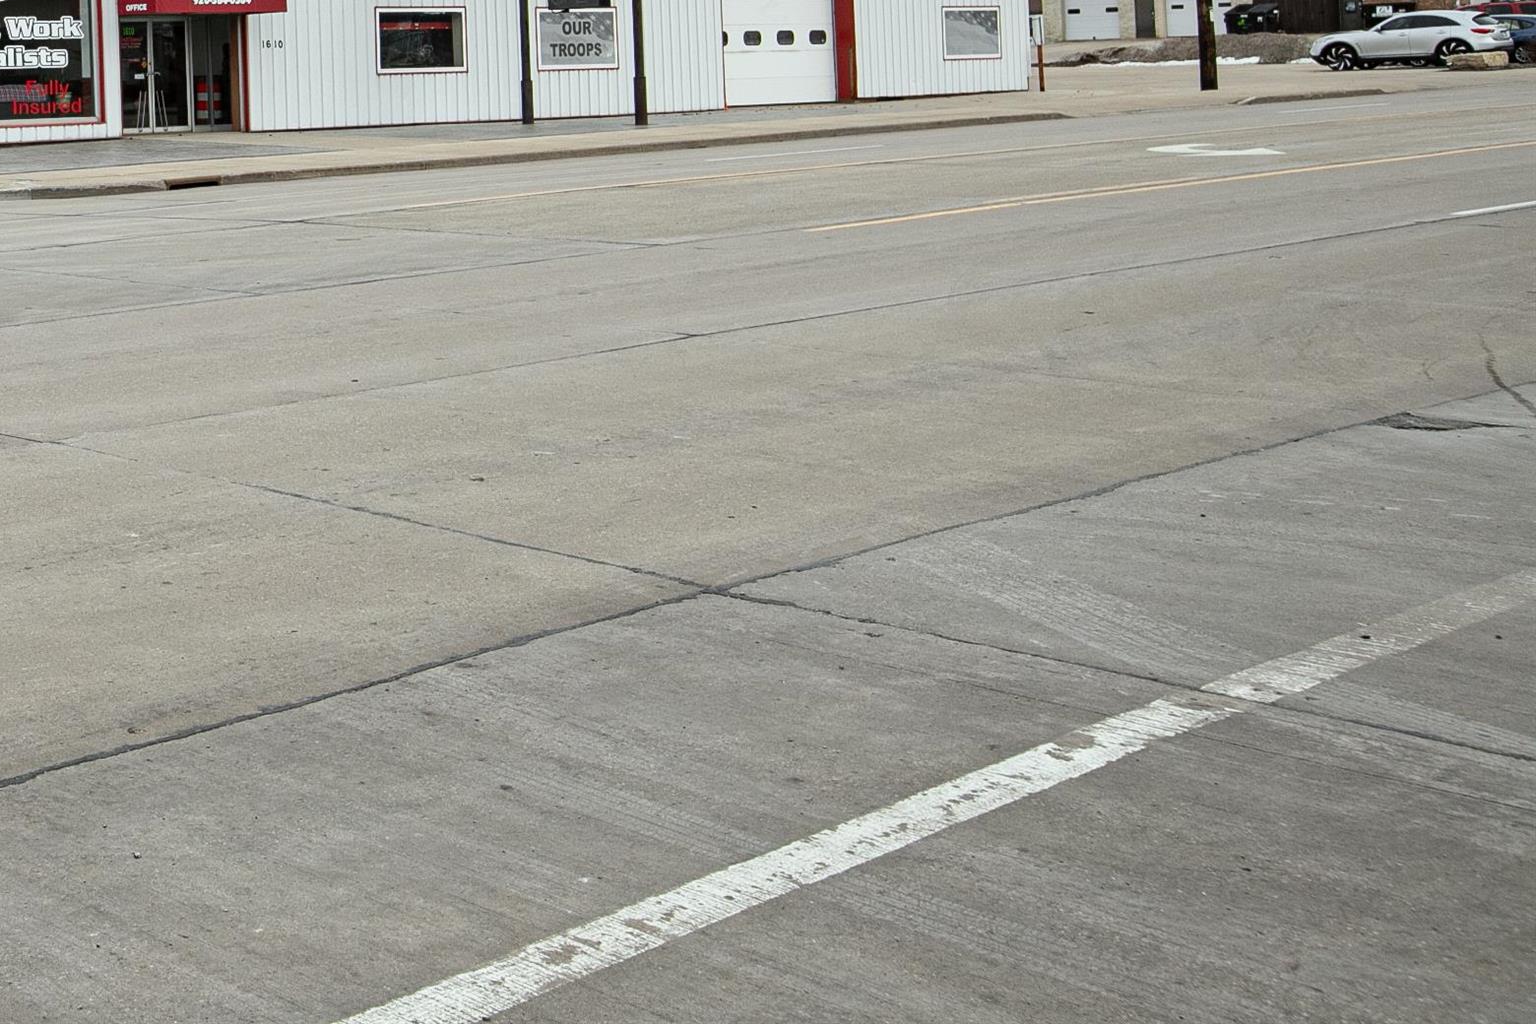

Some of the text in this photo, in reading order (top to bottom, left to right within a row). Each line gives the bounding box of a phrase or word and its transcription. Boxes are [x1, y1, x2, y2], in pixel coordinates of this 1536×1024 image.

[125, 3, 148, 12] OFFICE
[4, 15, 84, 40] Work
[562, 21, 593, 36] OUR
[261, 40, 284, 49] 1610
[550, 43, 603, 58] TROOPS
[24, 79, 70, 96] Fully
[12, 97, 82, 116] Insured
